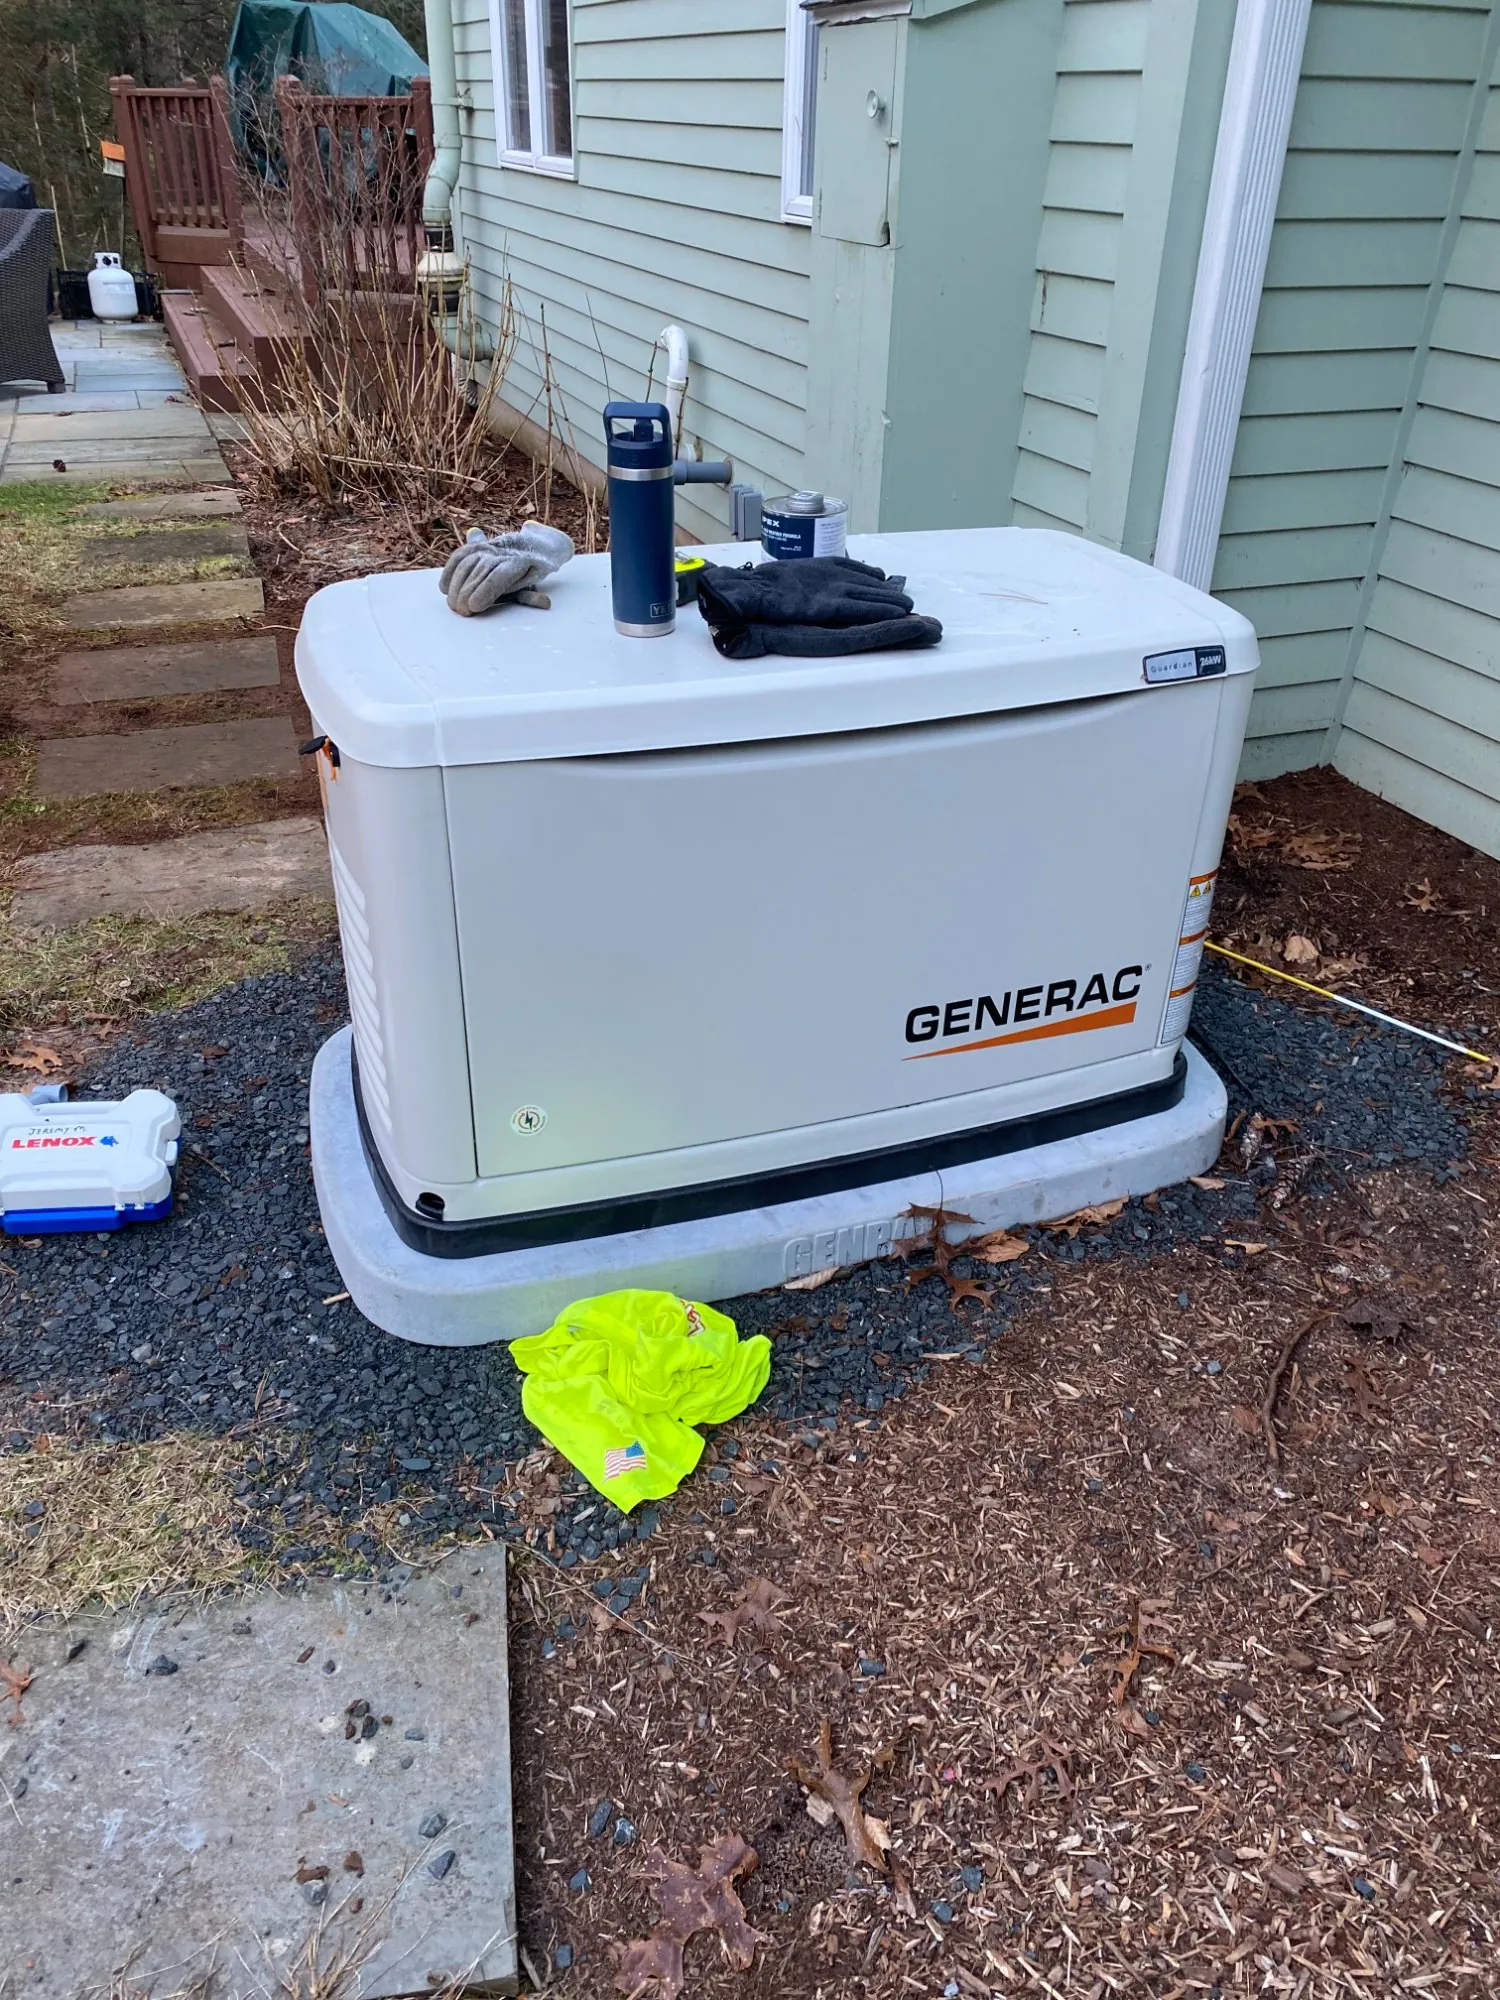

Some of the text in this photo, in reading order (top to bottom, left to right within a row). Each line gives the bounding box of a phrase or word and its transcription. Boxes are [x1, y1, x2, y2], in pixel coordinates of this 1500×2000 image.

[1150, 660, 1193, 673] Guardian
[905, 965, 1143, 1043] GENERAC
[12, 1136, 97, 1149] LENOX
